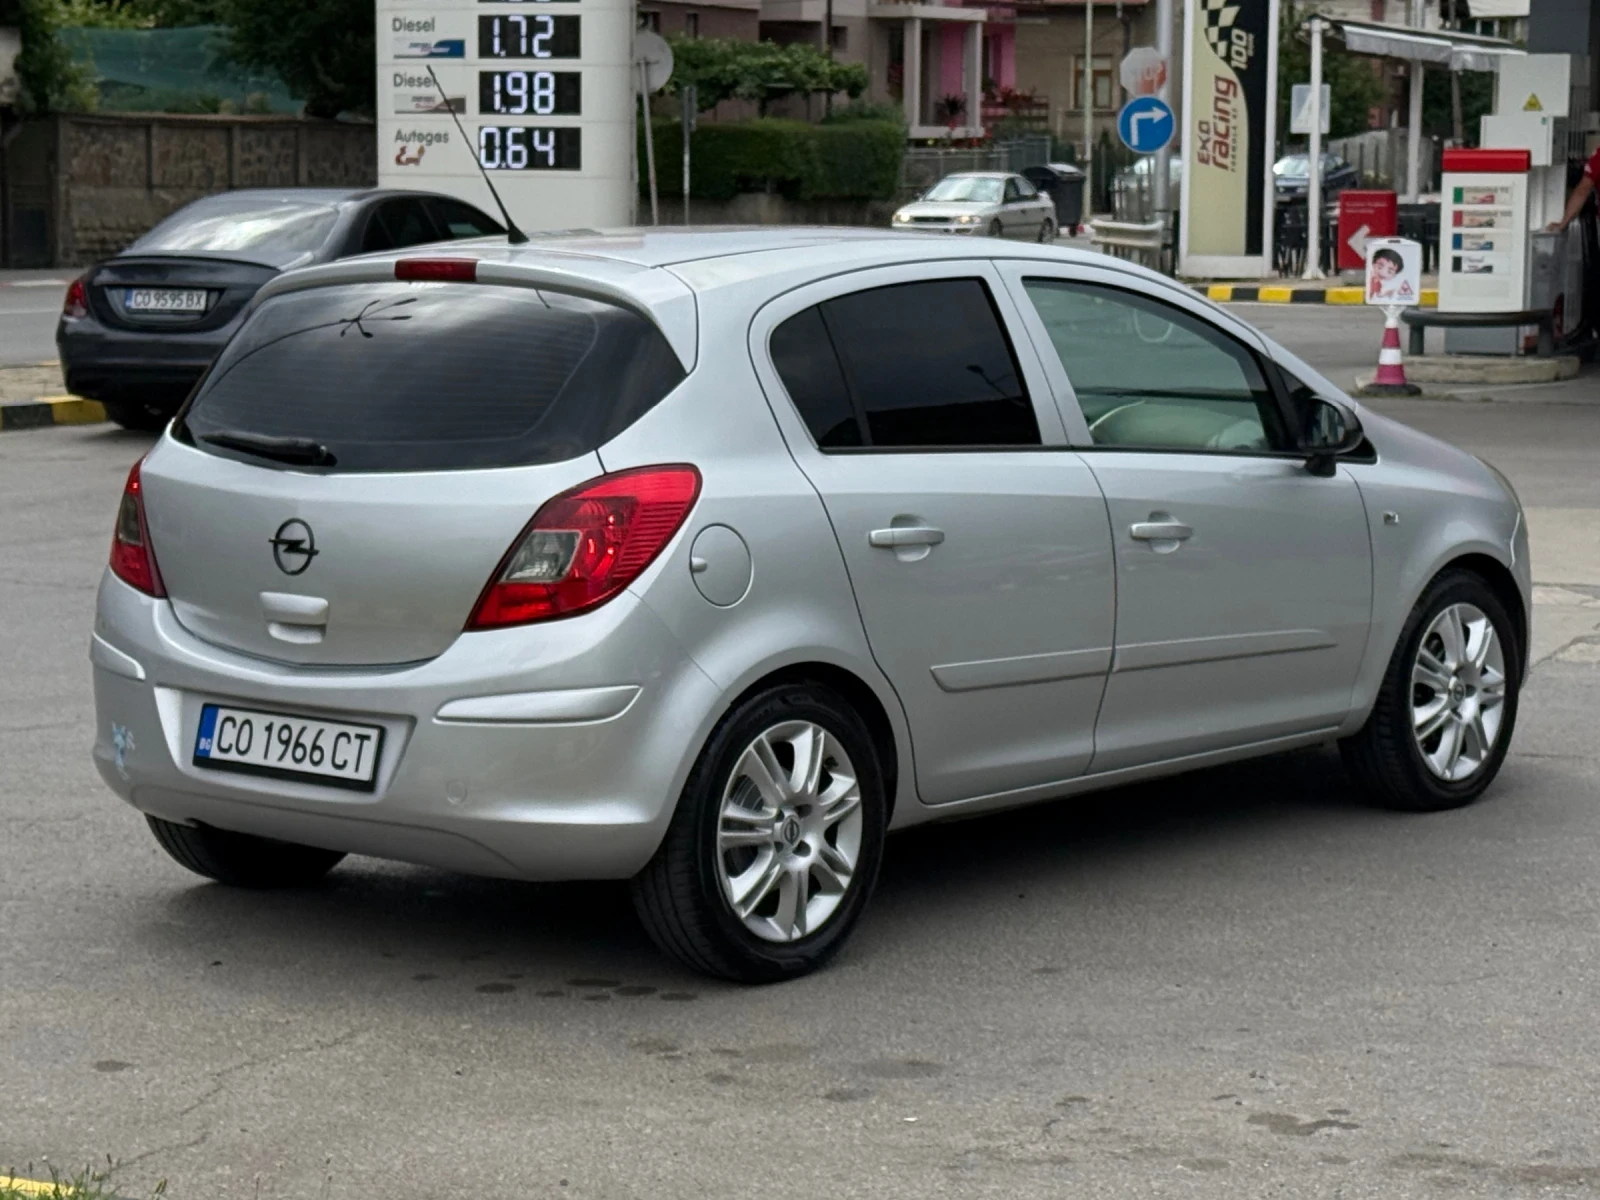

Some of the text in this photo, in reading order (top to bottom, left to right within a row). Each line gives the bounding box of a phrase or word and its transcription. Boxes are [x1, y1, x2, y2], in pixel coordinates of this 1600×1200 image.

[392, 16, 436, 33] Diesel
[492, 14, 554, 58] 1.72
[1231, 28, 1248, 70] 100
[493, 71, 555, 114] 1.98
[394, 128, 449, 146] Autogas
[1212, 75, 1238, 171] racing
[480, 127, 555, 169] 0.64
[134, 292, 151, 307] CO
[153, 292, 184, 308] 9595
[217, 716, 371, 773] CO 1966 CT
